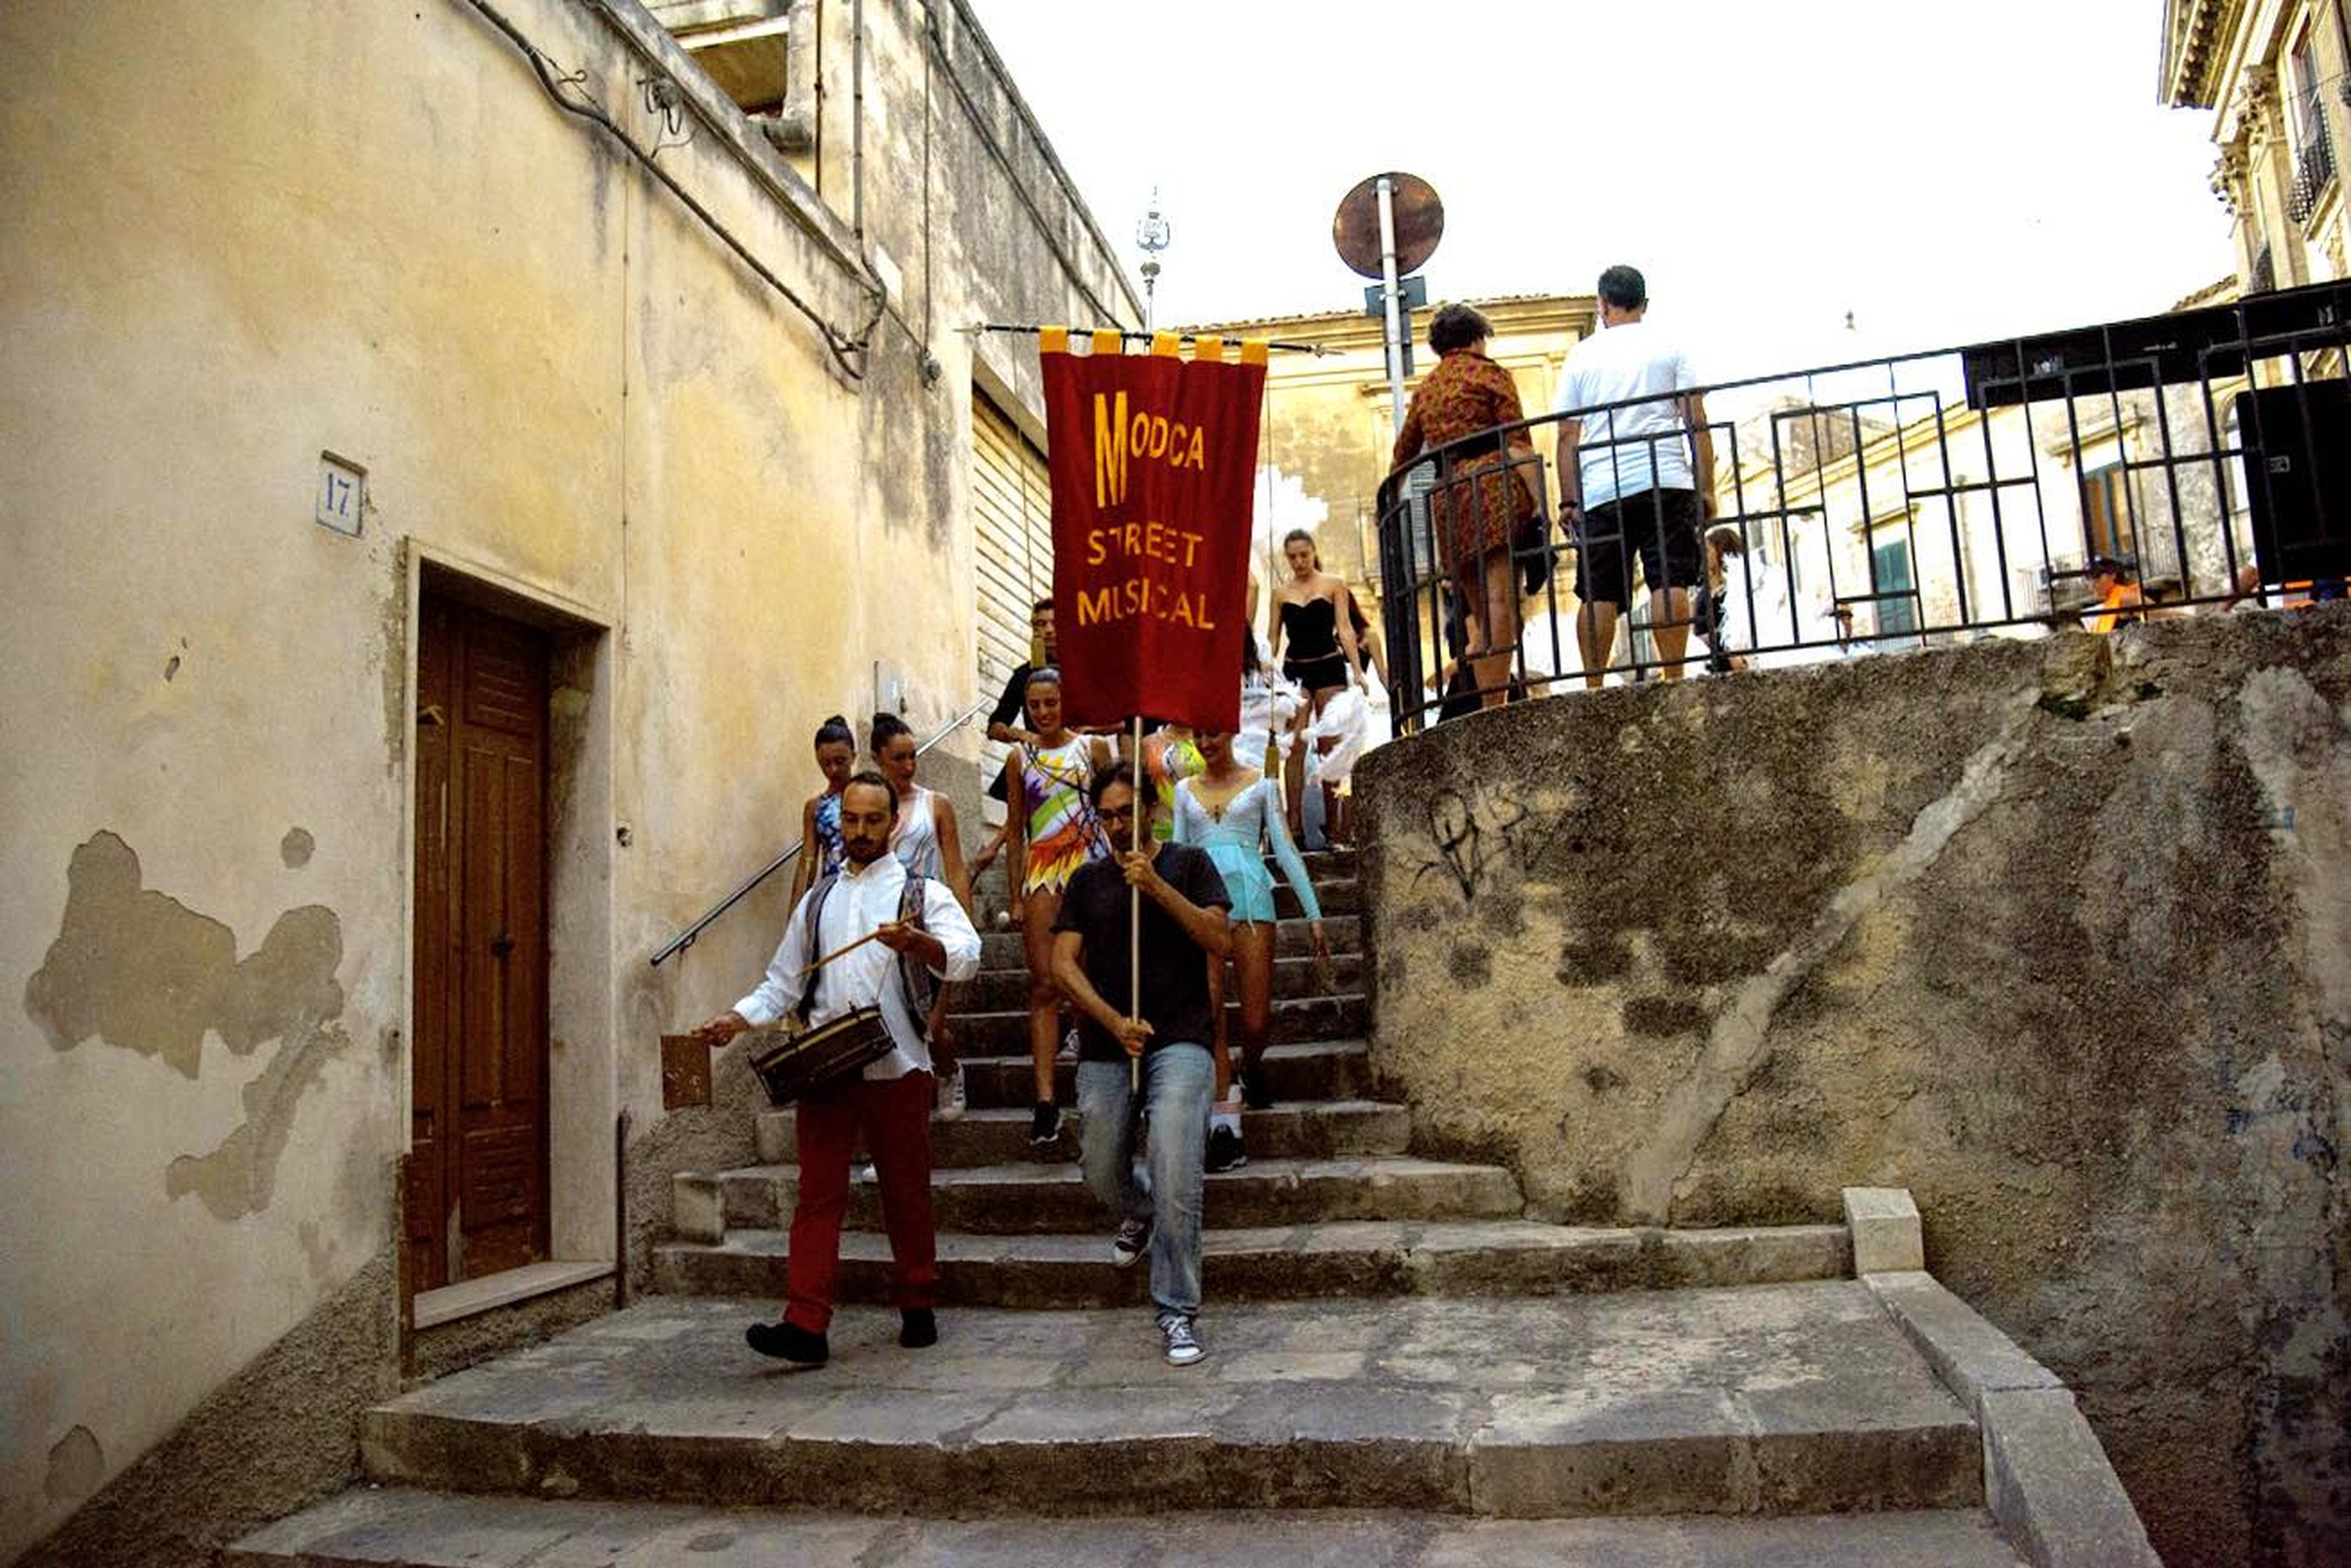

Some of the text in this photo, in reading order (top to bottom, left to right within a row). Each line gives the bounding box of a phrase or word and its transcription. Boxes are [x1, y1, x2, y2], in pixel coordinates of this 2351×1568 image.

[1094, 391, 1204, 508] MODCA
[328, 473, 350, 516] 17
[1087, 522, 1203, 567] STREET
